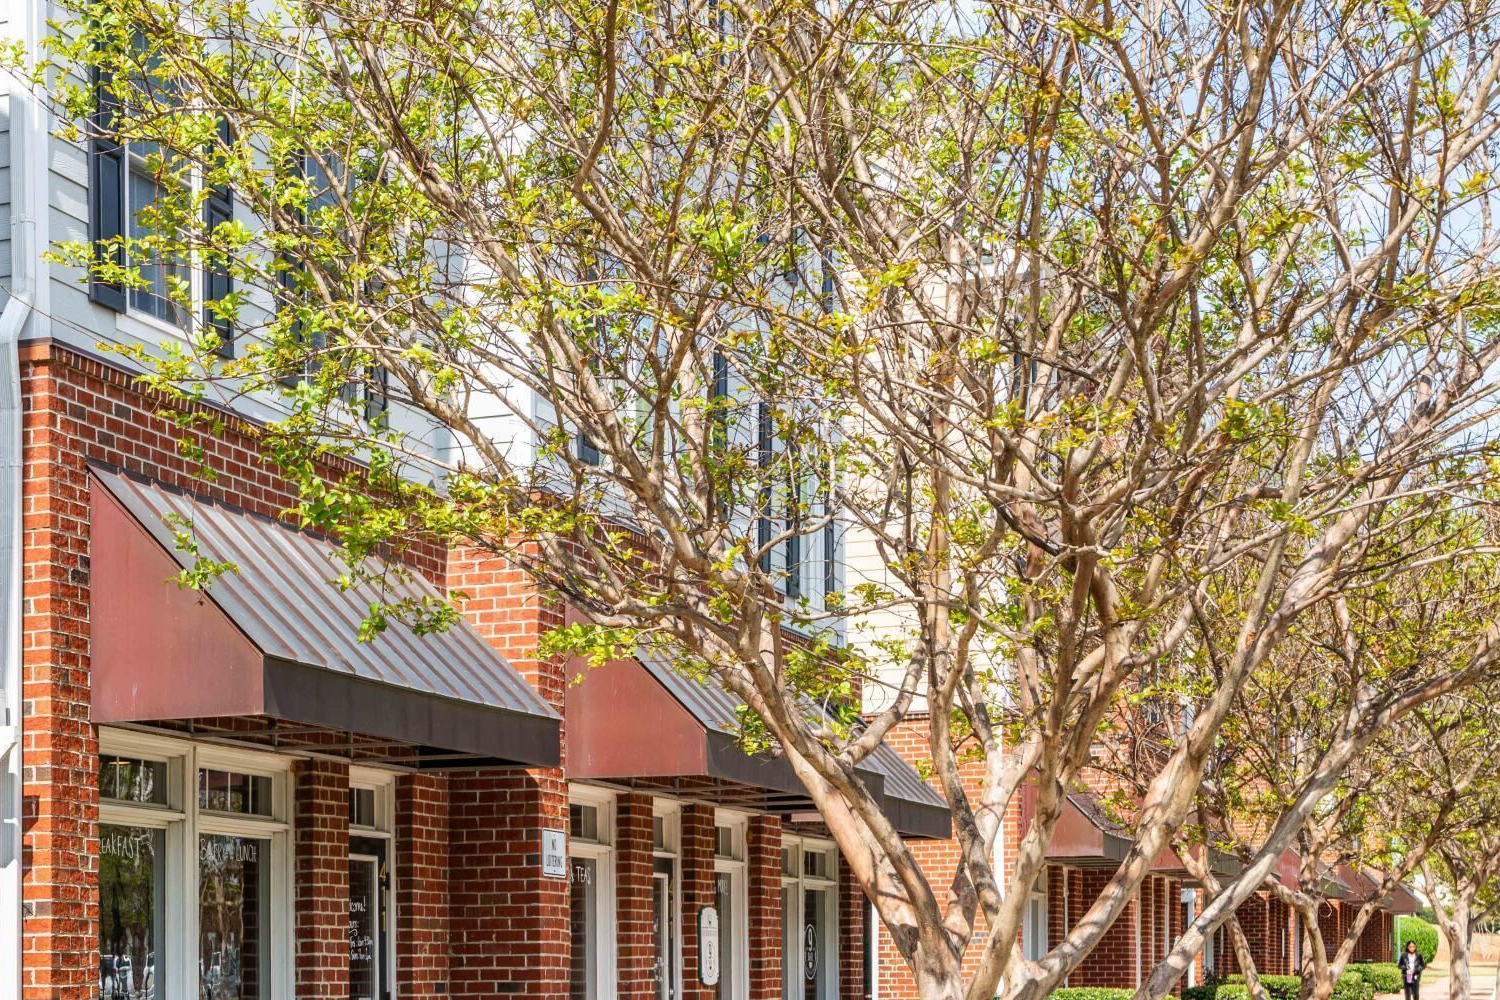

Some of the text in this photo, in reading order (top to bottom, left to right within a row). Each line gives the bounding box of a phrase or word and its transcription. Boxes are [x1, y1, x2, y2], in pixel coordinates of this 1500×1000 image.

[99, 832, 141, 859] EAKFAST
[235, 844, 257, 863] LUNCH
[576, 866, 591, 885] TEAS
